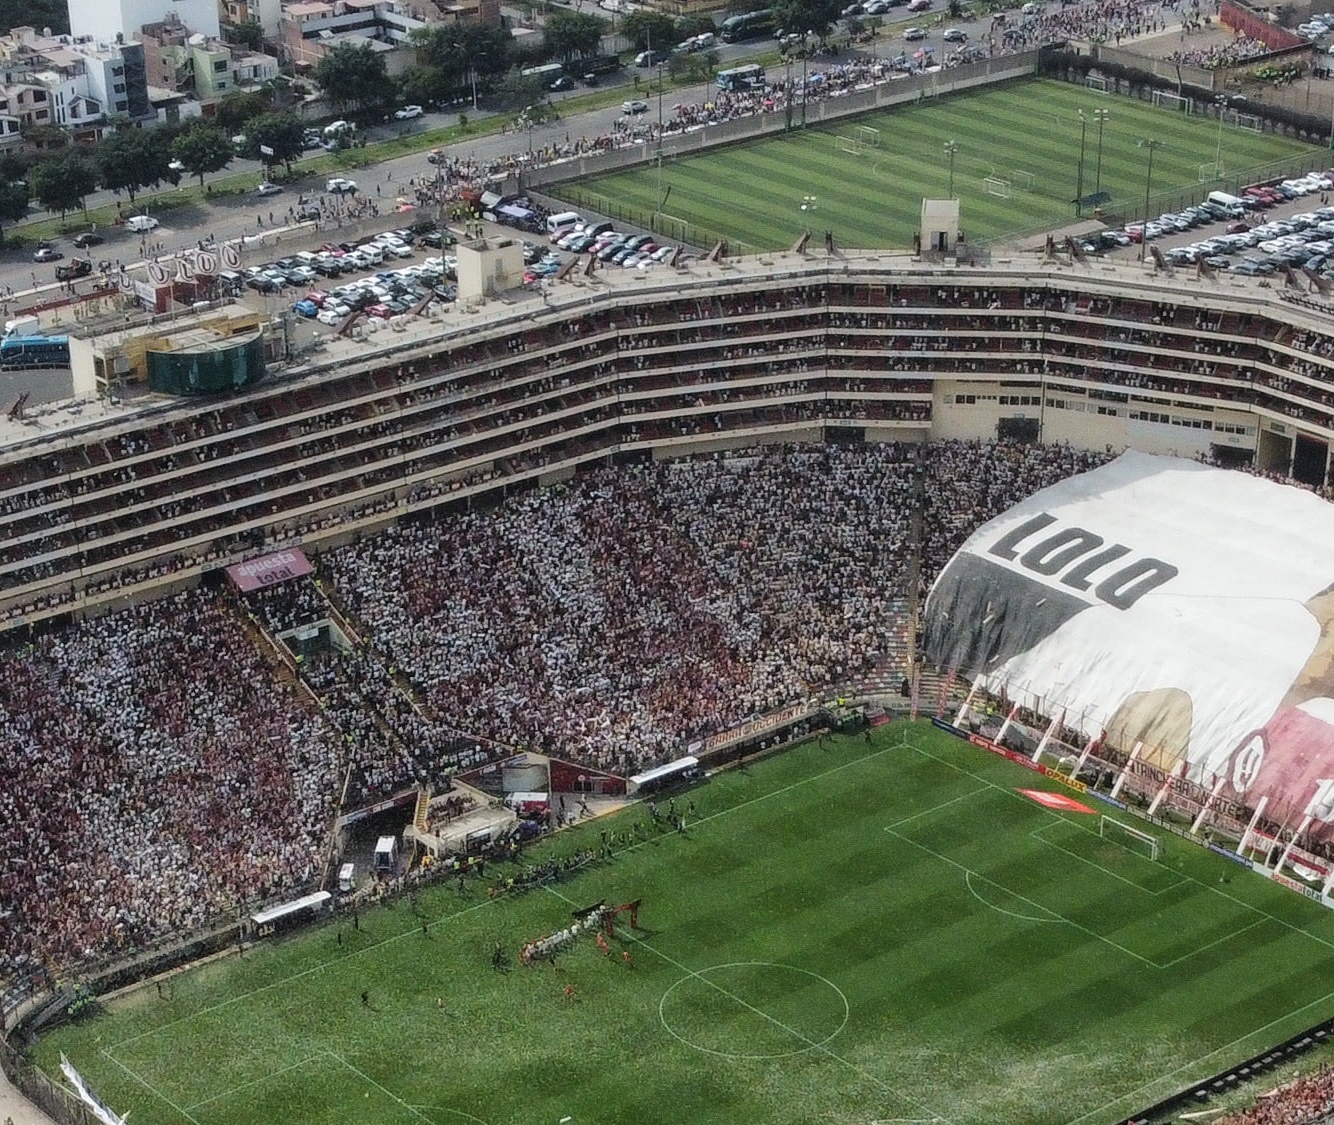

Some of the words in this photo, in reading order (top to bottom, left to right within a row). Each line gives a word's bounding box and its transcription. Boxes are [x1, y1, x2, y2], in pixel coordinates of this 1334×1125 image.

[237, 552, 297, 577] apuesta
[987, 512, 1179, 611] LOLO
[256, 566, 296, 585] total
[1046, 769, 1085, 792] OPALUX
[1201, 790, 1237, 817] NRTE
